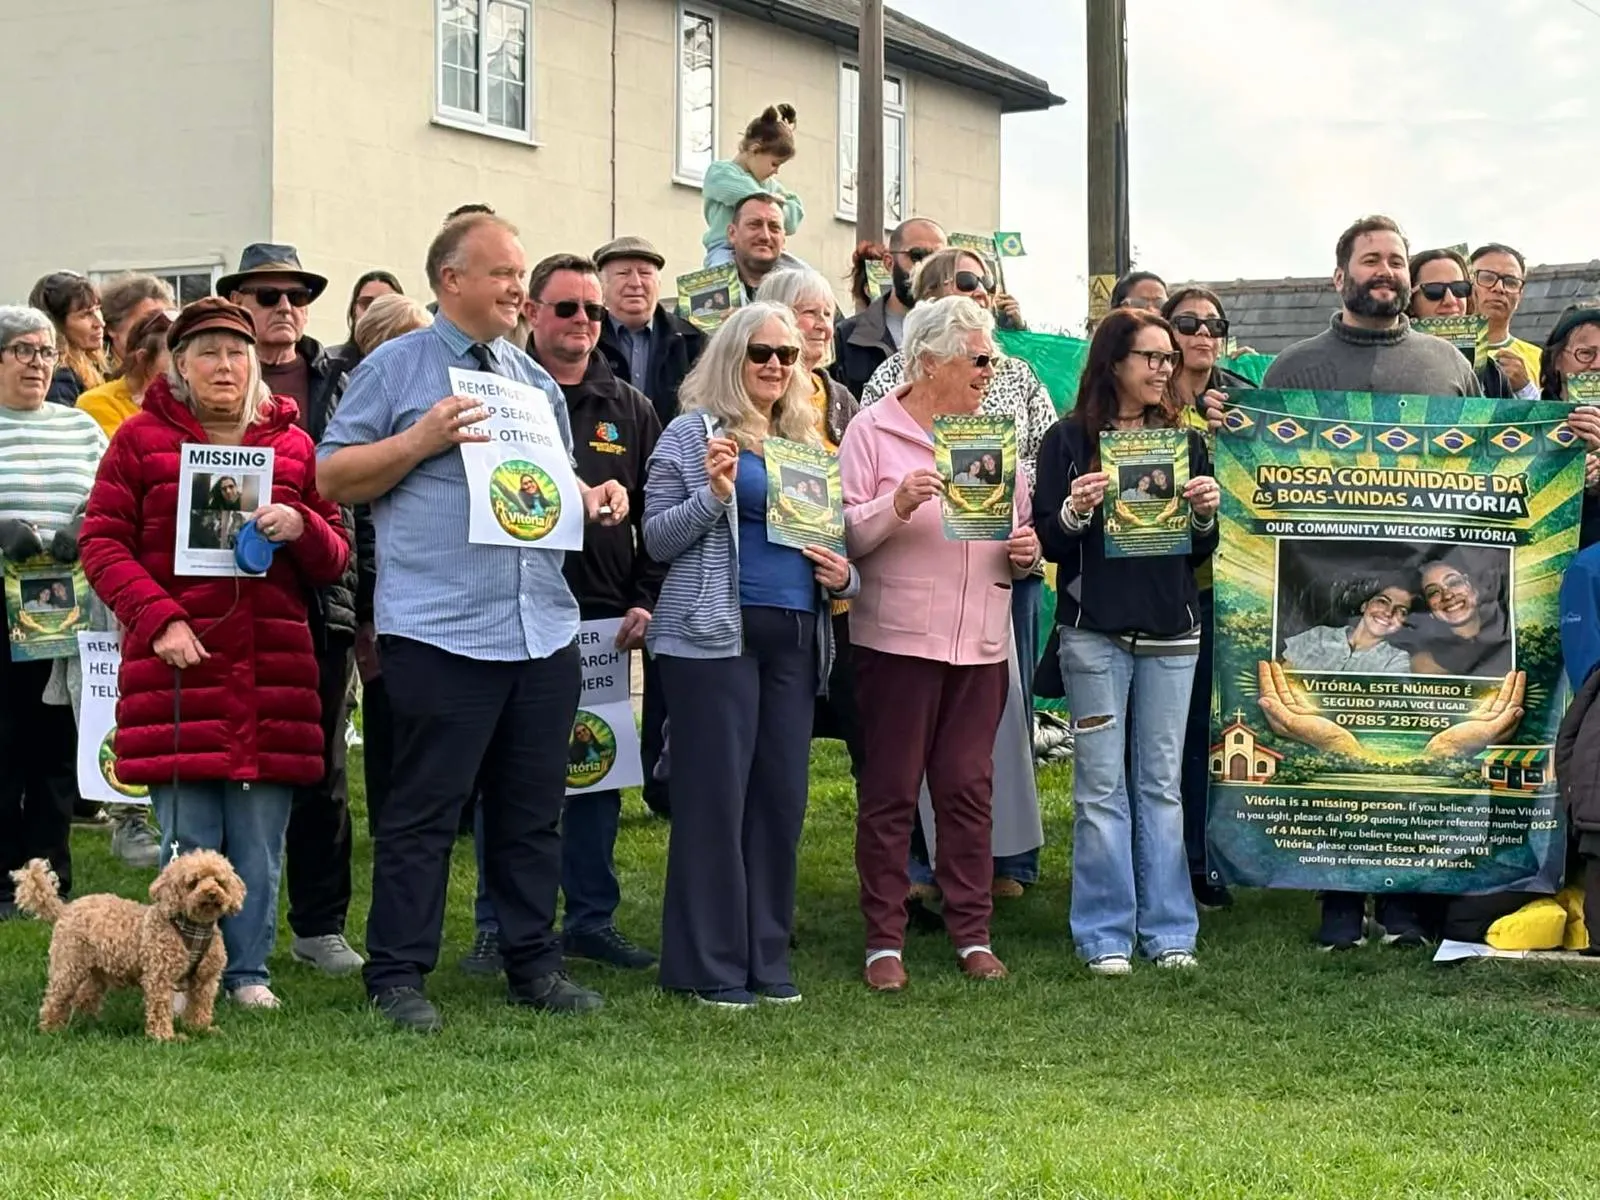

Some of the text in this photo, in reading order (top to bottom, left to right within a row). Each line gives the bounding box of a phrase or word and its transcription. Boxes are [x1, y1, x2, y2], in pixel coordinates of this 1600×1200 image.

[499, 429, 553, 447] OTHERS
[189, 450, 266, 467] MISSING
[1260, 466, 1523, 494] NOSSA COMUNIDADE DÁ
[1277, 489, 1408, 507] BOAS-VINDAS
[1412, 495, 1424, 507] A
[1428, 492, 1522, 513] VITÓRIA
[1266, 522, 1517, 542] OUR COMMUNITY WELCOMES VITÓRIA
[574, 632, 600, 645] BER
[580, 652, 619, 668] ARCH
[90, 663, 117, 675] HEL
[580, 675, 614, 691] HERS
[1370, 683, 1399, 693] ESTE
[1402, 682, 1460, 696] NÚMERO
[1464, 684, 1472, 696] É
[1322, 697, 1375, 708] SEGURO
[1378, 699, 1408, 709] PARA
[1336, 714, 1450, 729] 07885 287865
[566, 762, 600, 774] itória
[1244, 795, 1551, 816] Vitória is a missing person. If you believe you have Vitória
[1247, 812, 1265, 821] you
[1294, 812, 1323, 823] please
[1325, 813, 1343, 822] dial
[1345, 814, 1368, 823] 999
[1370, 816, 1408, 827] quoting
[1410, 816, 1443, 828] Misper
[1446, 818, 1490, 828] reference
[1492, 820, 1528, 829] number
[1530, 820, 1558, 830] 0622
[1265, 825, 1523, 845] of 4 March. If you believe you have previously sighted
[1274, 838, 1489, 856] Vitória, please contact Essex Police on 101
[1299, 855, 1476, 869] quoting reference 0622 of 4 March.
